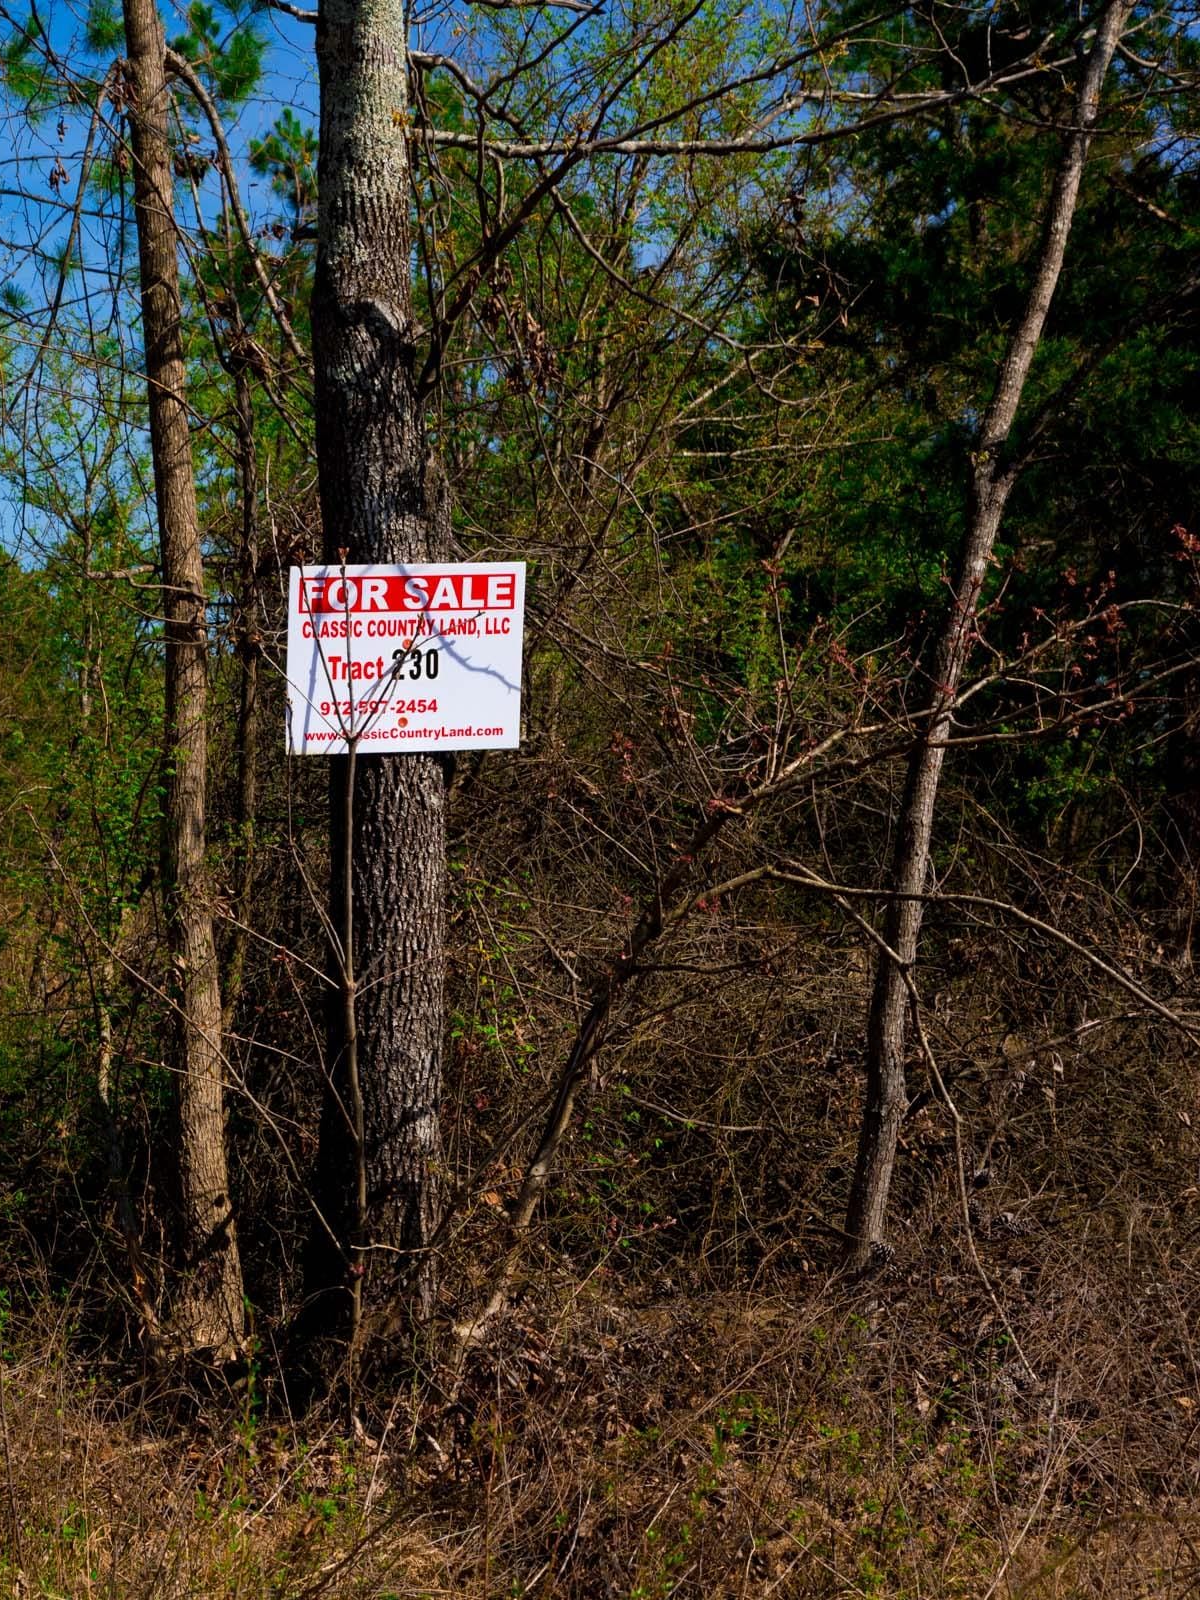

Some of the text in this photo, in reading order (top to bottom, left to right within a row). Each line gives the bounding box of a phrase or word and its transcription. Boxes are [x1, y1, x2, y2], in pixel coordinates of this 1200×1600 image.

[302, 577, 511, 612] FOR SALE
[367, 619, 434, 637] COUNTRY
[440, 618, 480, 638] LAND,
[485, 618, 510, 634] LLC
[328, 649, 439, 680] Tract 230
[321, 699, 438, 715] 972-597-2454
[304, 726, 503, 741] www.ssicCountryLand.com
